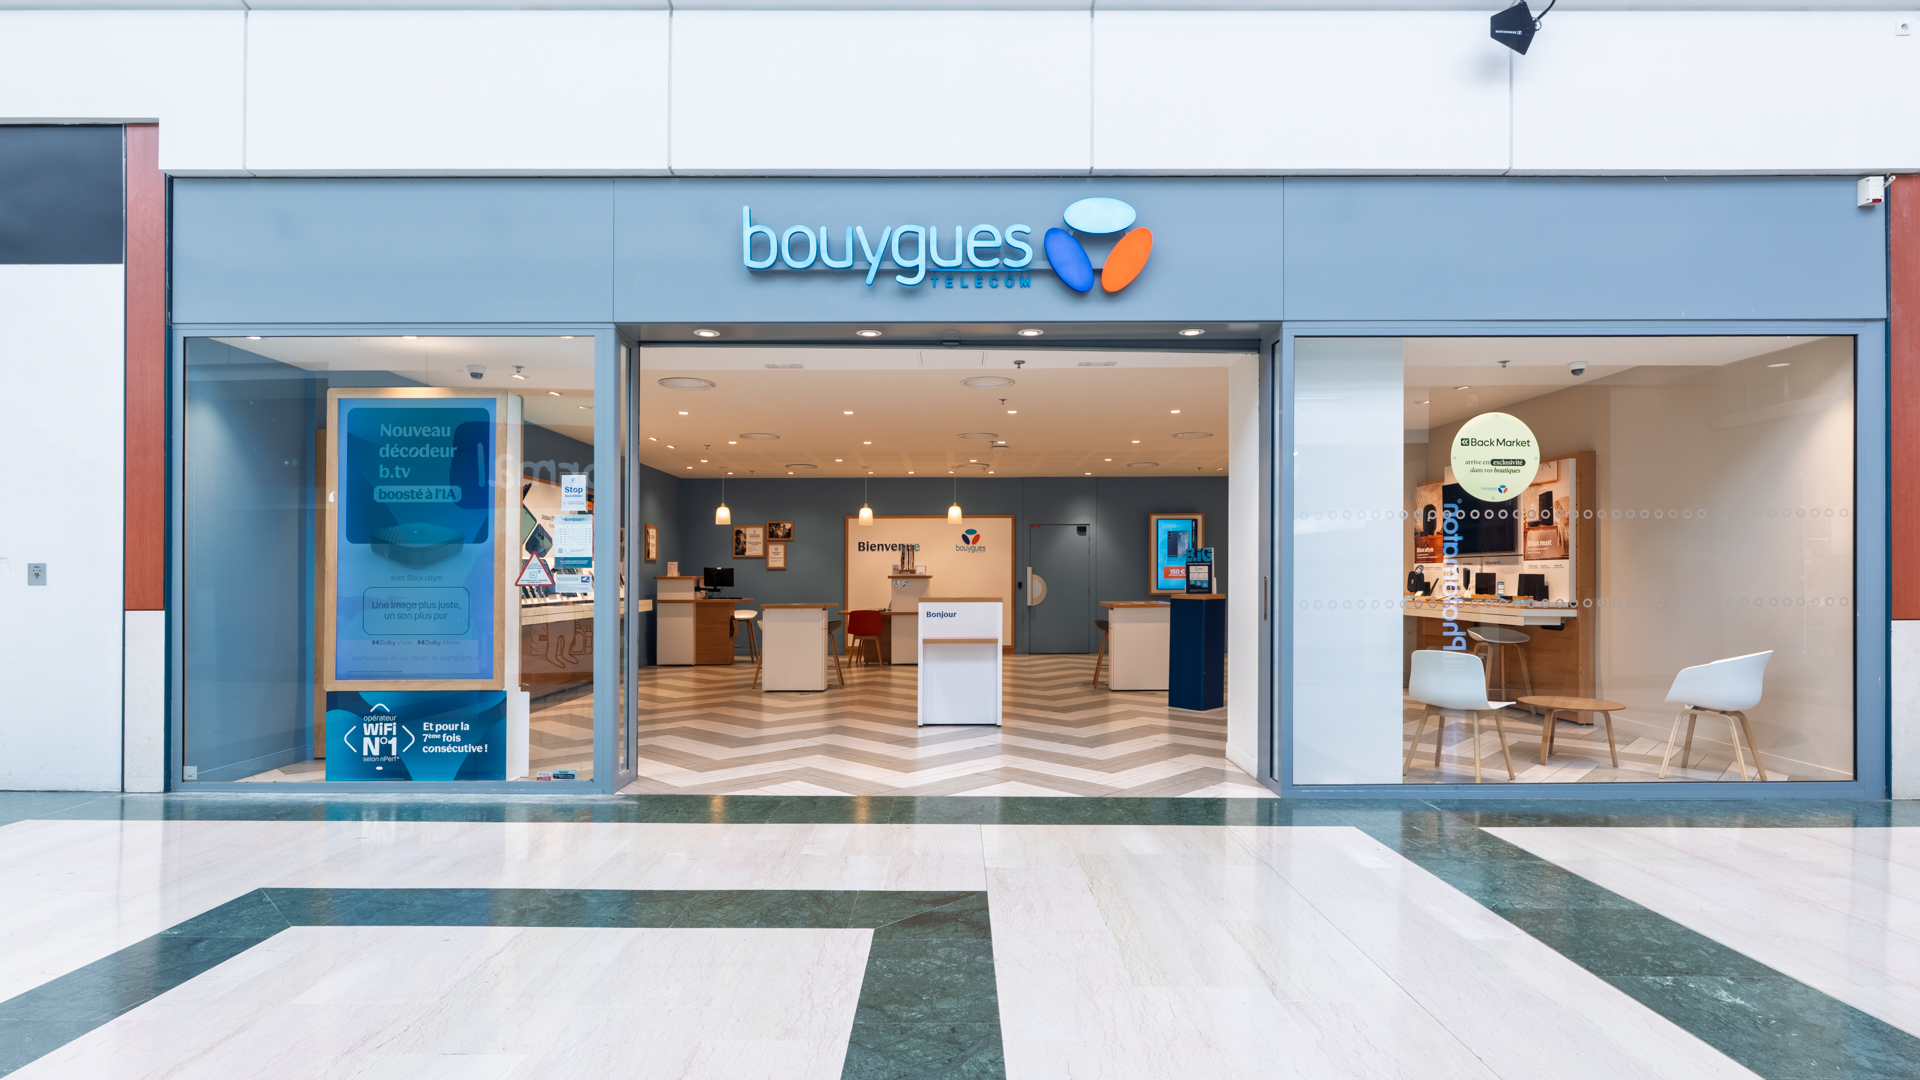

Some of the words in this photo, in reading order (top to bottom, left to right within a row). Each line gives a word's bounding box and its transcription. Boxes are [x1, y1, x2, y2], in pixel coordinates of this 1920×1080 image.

[742, 205, 1034, 286] bouygues
[930, 276, 1032, 288] TELECOM
[380, 423, 451, 437] Nouveau
[1471, 438, 1495, 447] Back
[1496, 438, 1531, 447] Market
[379, 444, 457, 458] décodeur
[379, 464, 411, 479] b.tv
[378, 488, 424, 500] boosté
[425, 488, 433, 500] à
[435, 488, 456, 500] l'IA
[564, 486, 584, 494] Stop
[955, 544, 986, 553] bouygues
[425, 574, 443, 582] ultym
[372, 601, 389, 609] Une
[391, 601, 417, 610] image
[419, 601, 436, 610] plus
[438, 601, 461, 610] juste,
[414, 612, 432, 621] plus
[434, 613, 448, 621] pur
[926, 611, 957, 619] Bonjour
[363, 722, 397, 736] WiFi
[423, 722, 434, 731] Et
[435, 723, 459, 733] pour
[461, 722, 470, 731] la
[442, 733, 461, 742] fois
[422, 744, 483, 753] consécutive
